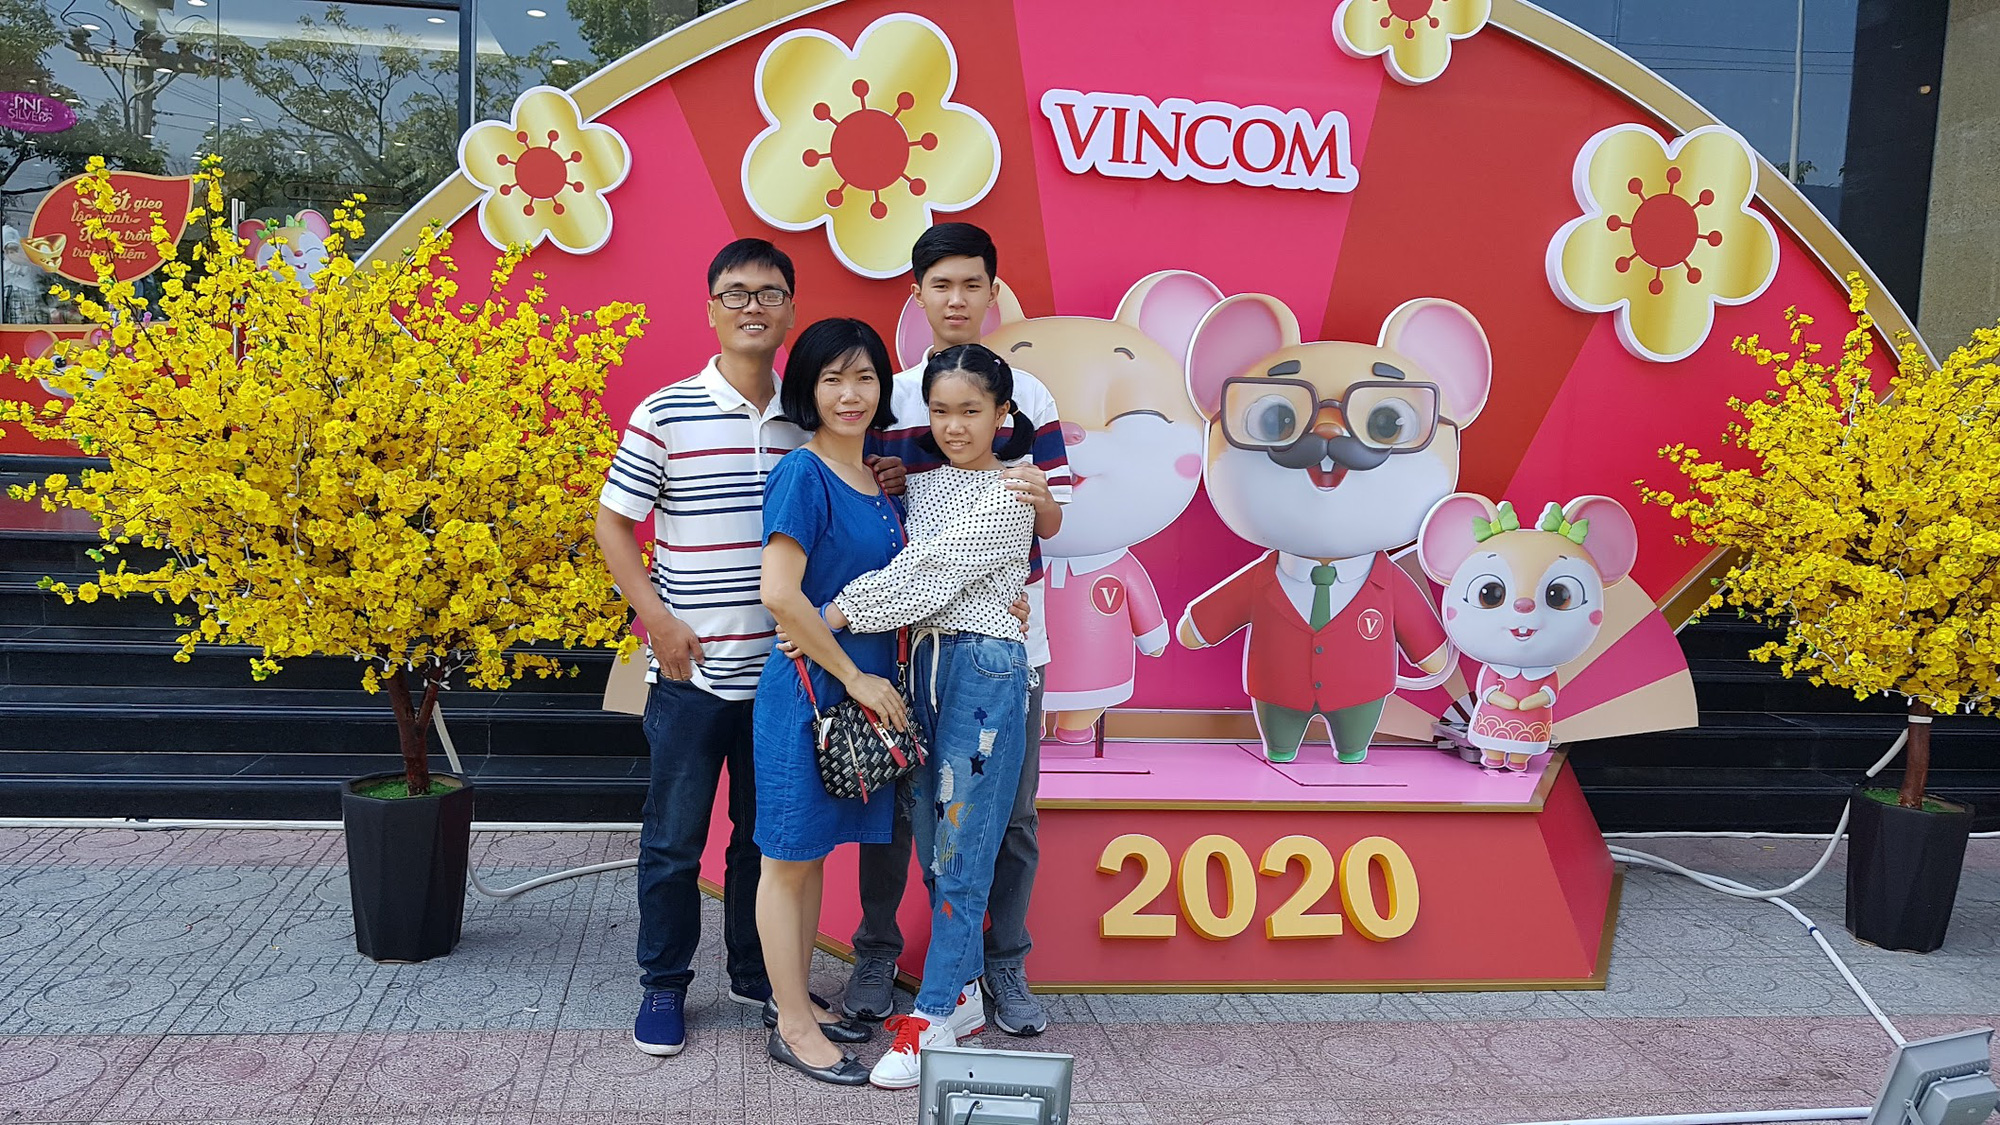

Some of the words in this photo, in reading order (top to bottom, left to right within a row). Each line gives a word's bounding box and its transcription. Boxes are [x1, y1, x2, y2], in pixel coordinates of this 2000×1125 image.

[14, 94, 42, 114] PNJ
[8, 107, 48, 122] SILVER
[1054, 103, 1346, 179] VINCOM
[133, 197, 163, 213] gieo
[96, 212, 130, 224] anh
[125, 228, 156, 246] trồn
[1099, 587, 1119, 609] V
[1365, 618, 1380, 634] V
[1096, 833, 1420, 942] 2020
